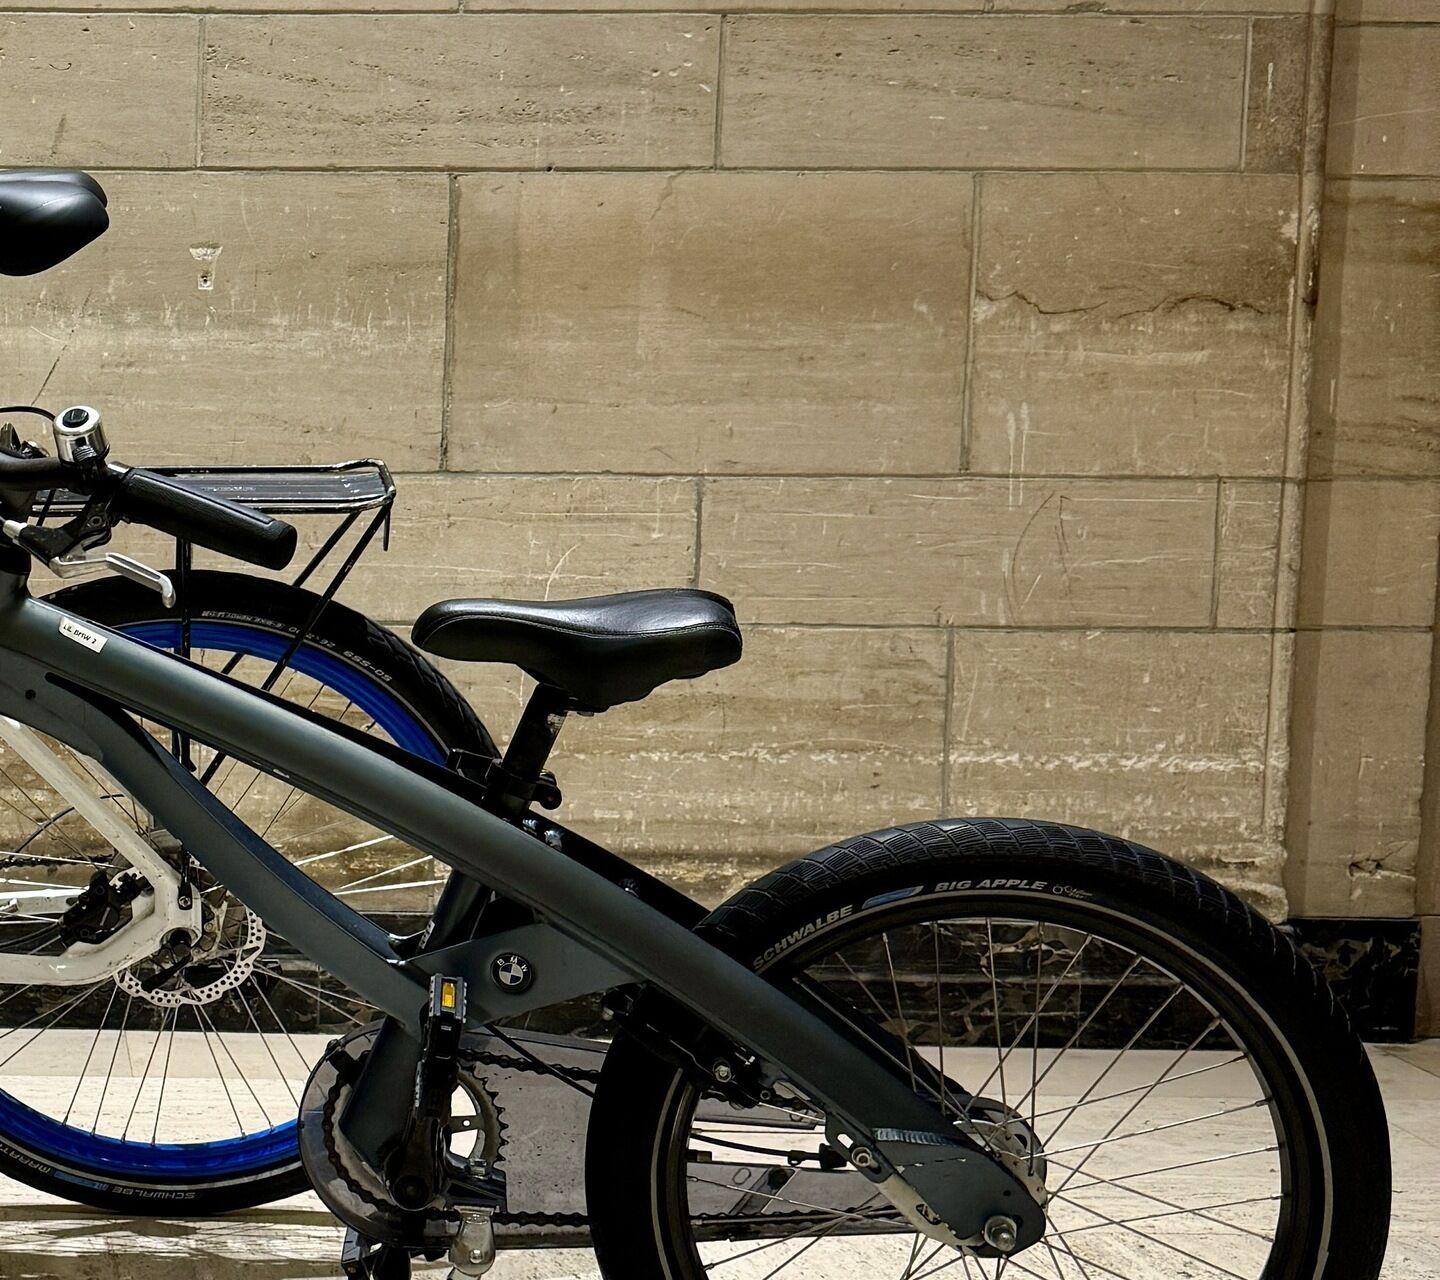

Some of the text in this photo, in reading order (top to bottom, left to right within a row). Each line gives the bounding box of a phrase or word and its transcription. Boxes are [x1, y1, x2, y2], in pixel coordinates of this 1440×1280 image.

[73, 630, 91, 641] BMW
[753, 879, 1048, 970] SCHWALBE BIG APPLE
[496, 954, 528, 972] BMW
[112, 1185, 195, 1200] SCHWALBE
